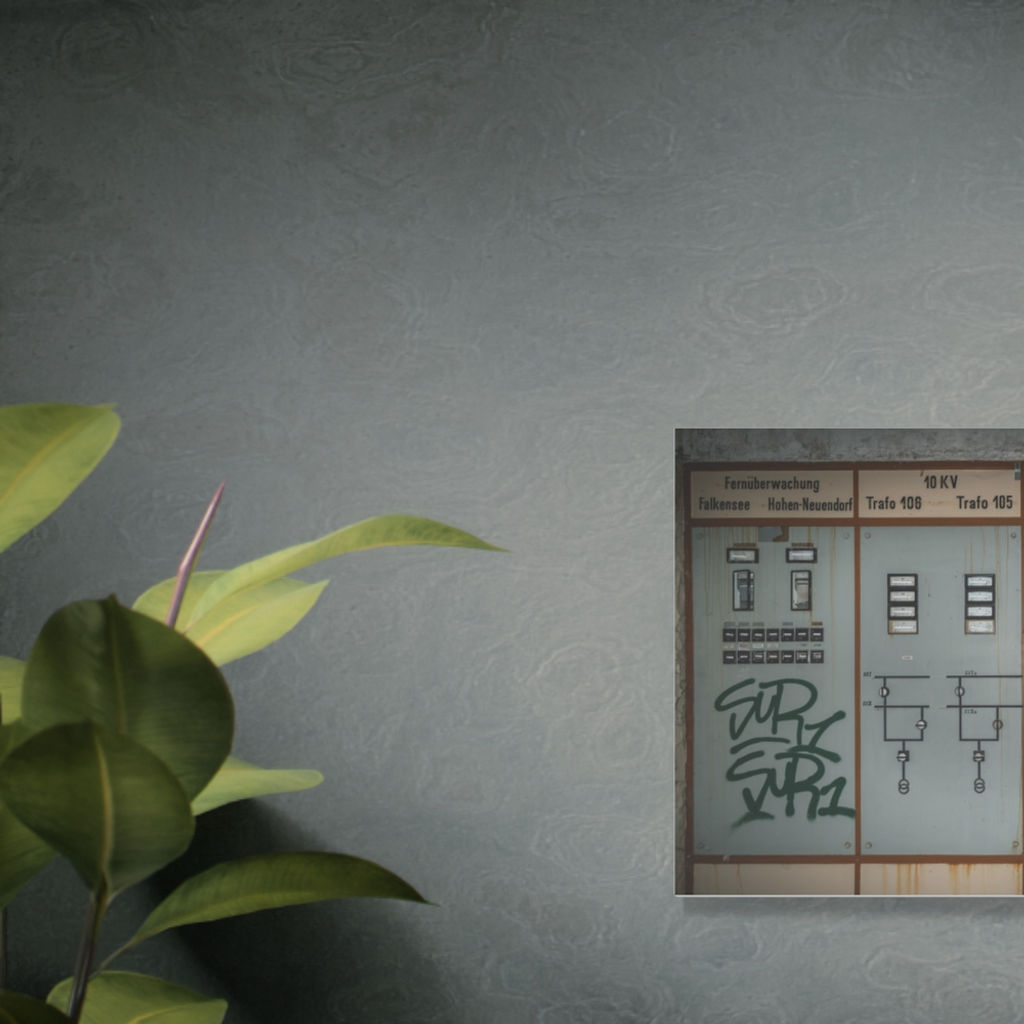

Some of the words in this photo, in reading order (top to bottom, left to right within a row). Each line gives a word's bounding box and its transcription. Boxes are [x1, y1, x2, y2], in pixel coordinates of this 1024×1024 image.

[724, 476, 820, 493] Fernüberwachung
[924, 475, 937, 489] 10
[940, 475, 958, 489] KV
[699, 497, 751, 511] Falkensee
[768, 497, 853, 512] Hohen-Neuendorf
[866, 496, 896, 510] Trafo
[957, 495, 988, 509] Trafo
[993, 495, 1013, 509] 105
